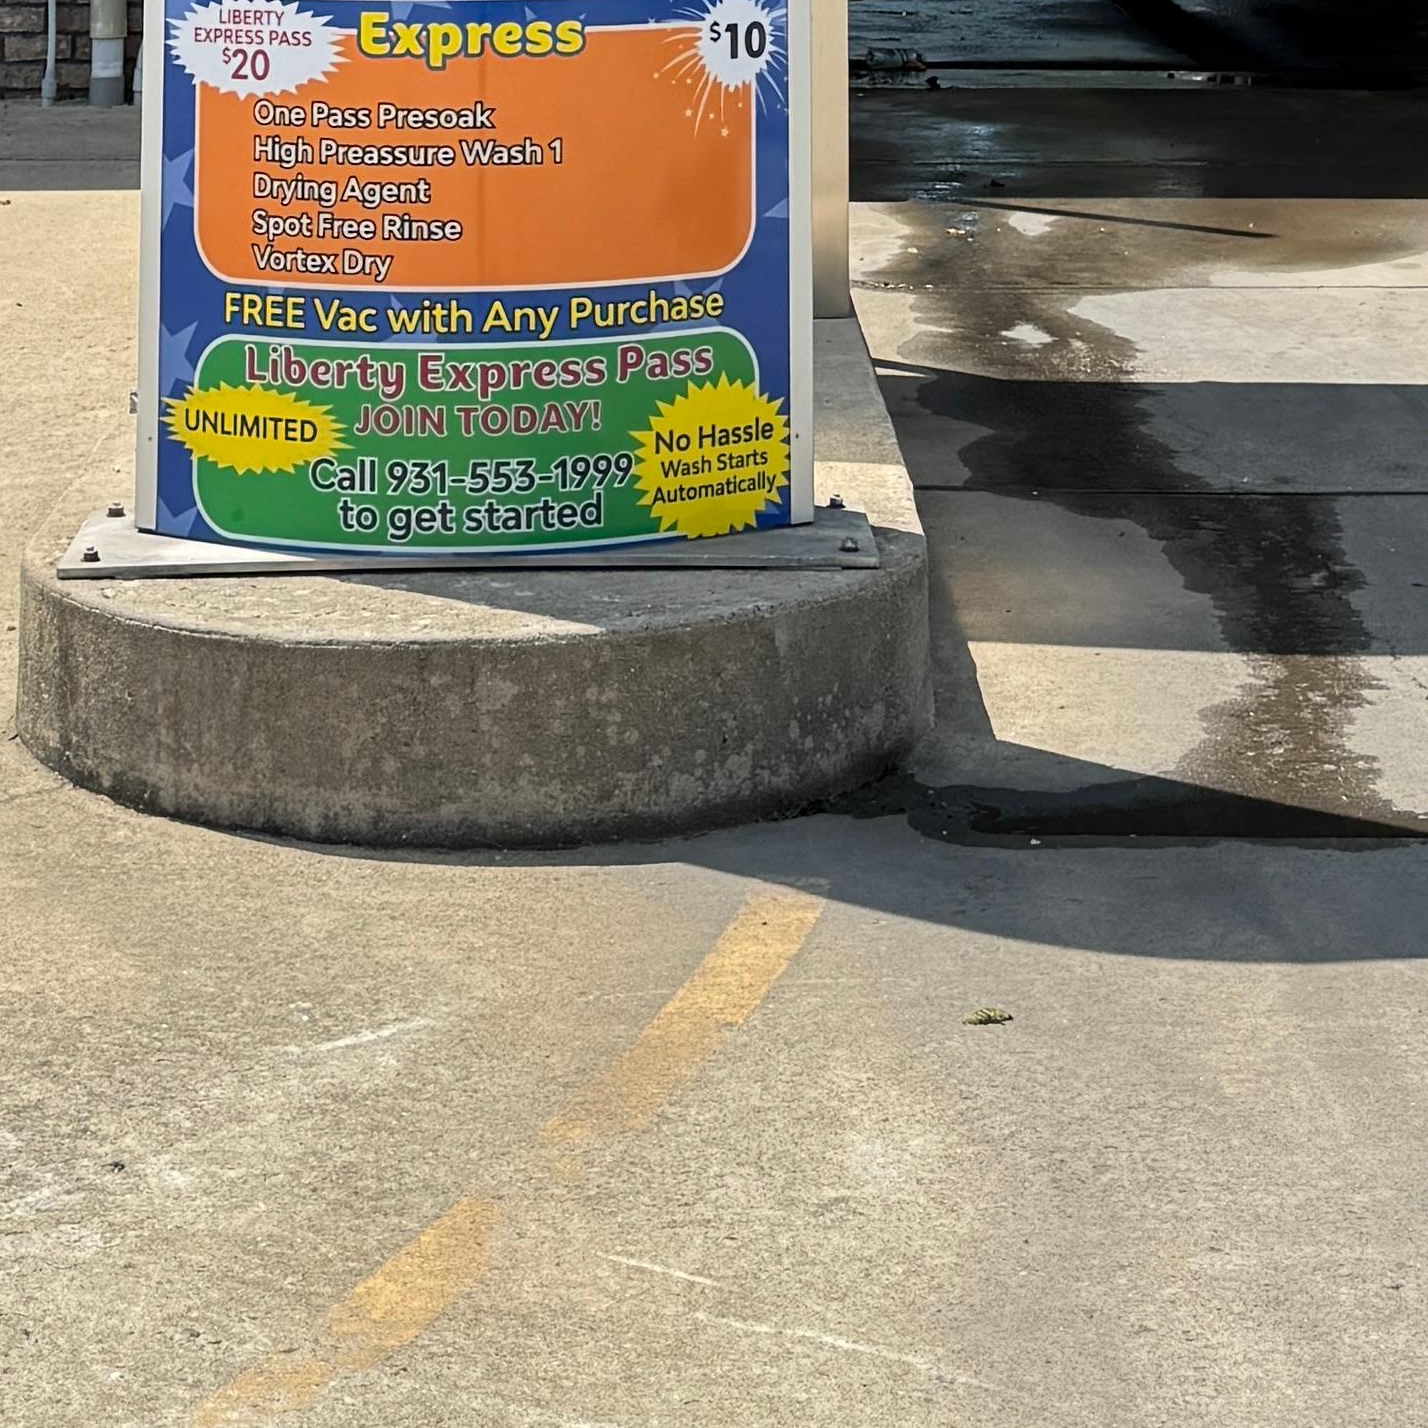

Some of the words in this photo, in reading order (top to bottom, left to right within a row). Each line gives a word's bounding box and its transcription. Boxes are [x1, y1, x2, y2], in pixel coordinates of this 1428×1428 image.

[219, 9, 284, 25] LIBERTY
[194, 27, 263, 44] EXPRESS
[269, 29, 311, 47] PASS
[357, 10, 586, 68] Express
[710, 21, 765, 59] $10
[222, 48, 269, 80] $20
[254, 102, 305, 126] One
[312, 103, 370, 128] Pass
[378, 103, 495, 129] Presoak
[253, 137, 312, 166] High
[320, 139, 454, 166] Preassure
[461, 139, 542, 165] Wash
[549, 139, 562, 163] 1
[253, 175, 337, 206] Drying
[343, 178, 430, 205] Agent
[252, 211, 311, 242] Spot
[317, 214, 375, 239] Free
[382, 216, 462, 240] Rinse
[252, 246, 337, 274] Vortex
[343, 249, 392, 281] Dry
[224, 292, 304, 327] FREE
[314, 299, 376, 332] Vac
[387, 300, 472, 333] with
[483, 302, 559, 339] Any
[571, 291, 724, 332] Purchase
[245, 345, 404, 399] Liberty
[418, 352, 606, 399] Express
[618, 345, 713, 381] Pass
[185, 408, 318, 442] UNLIMITED
[355, 403, 448, 436] JOIN
[456, 401, 601, 436] TODAY!
[655, 429, 691, 454] No
[697, 417, 773, 450] Hassle
[310, 459, 376, 494] Call
[387, 453, 633, 494] 931-553-1999
[661, 455, 713, 478] Wash
[718, 449, 768, 473] Starts
[652, 473, 776, 506] Automatically
[340, 499, 372, 531] to
[388, 500, 455, 539] get
[465, 492, 602, 531] started
